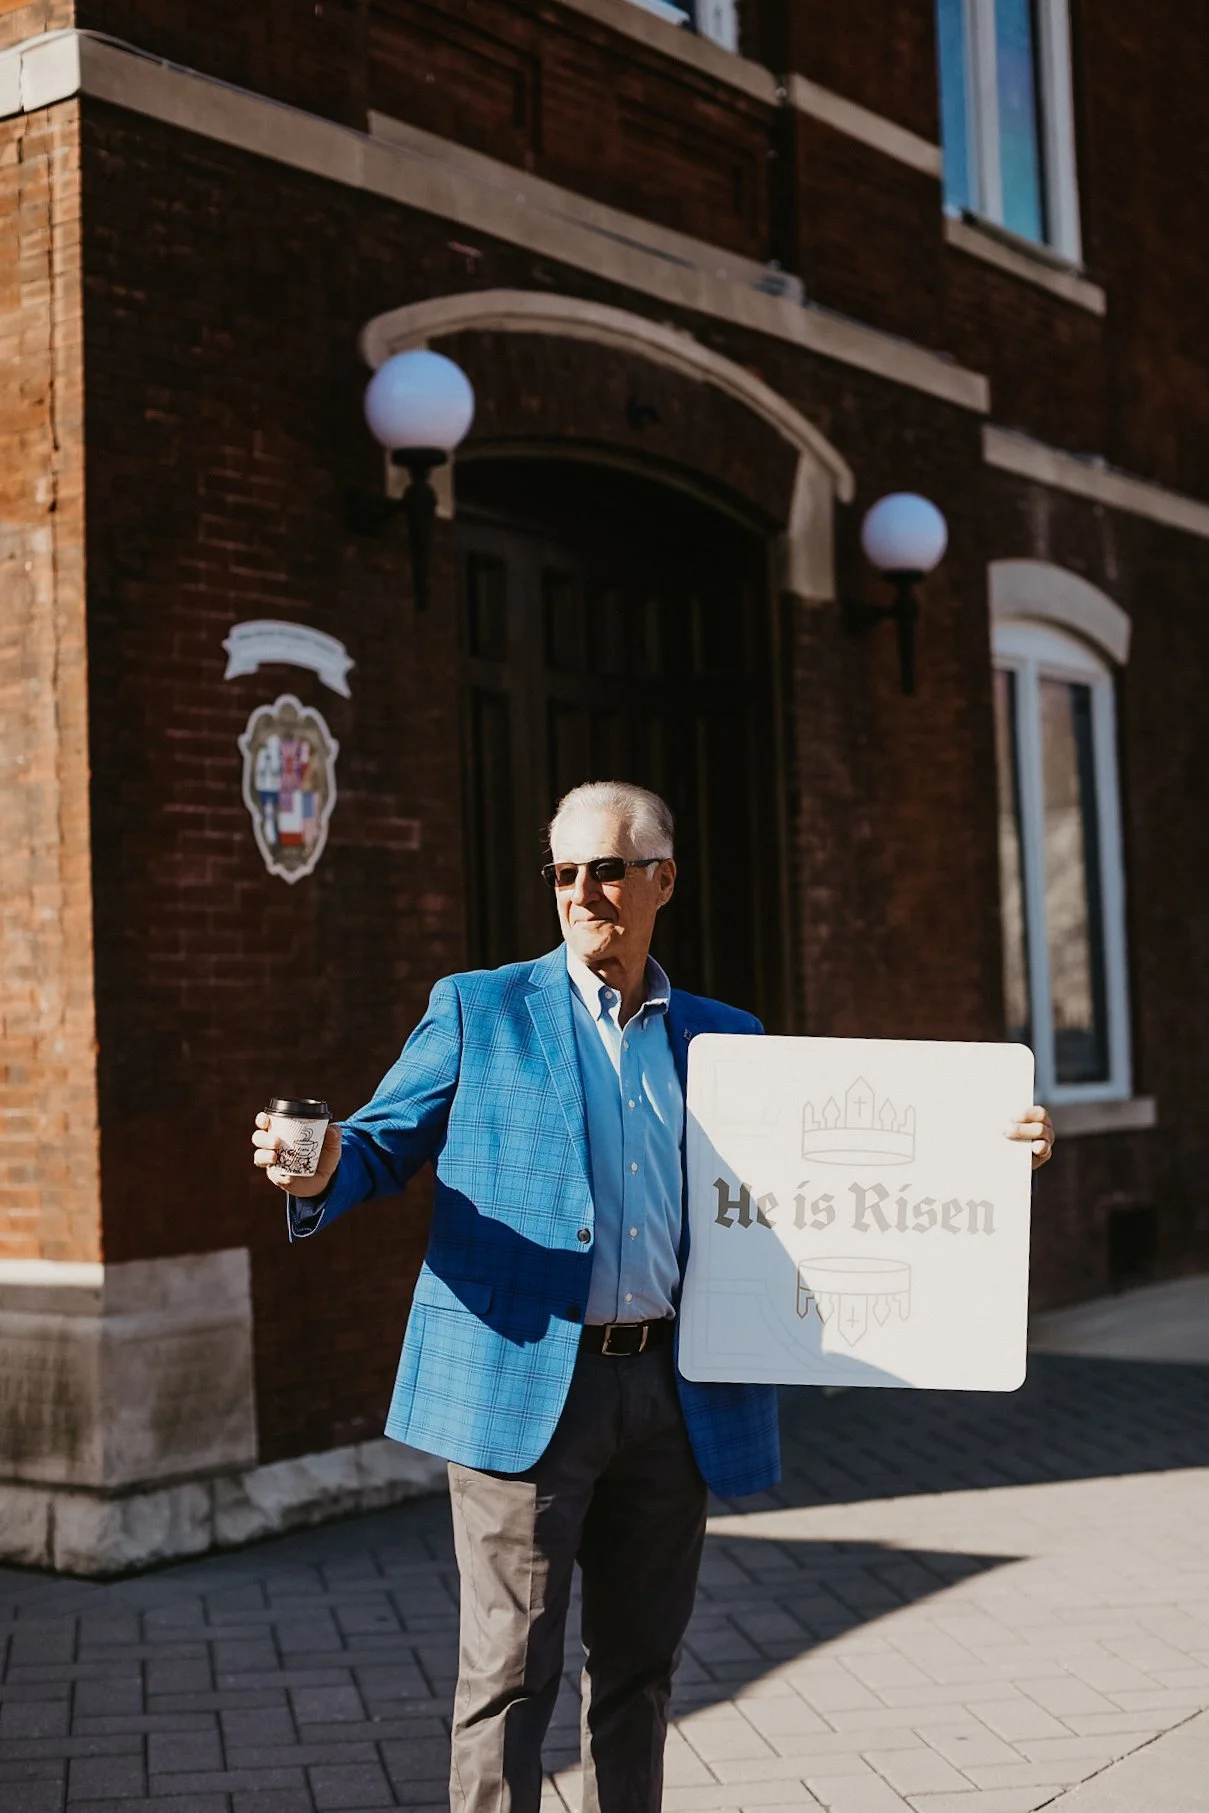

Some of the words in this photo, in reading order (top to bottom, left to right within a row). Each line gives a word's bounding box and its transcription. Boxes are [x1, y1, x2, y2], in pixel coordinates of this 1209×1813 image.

[713, 1177, 779, 1230] He
[793, 1180, 836, 1231] is
[848, 1182, 996, 1235] Risen
